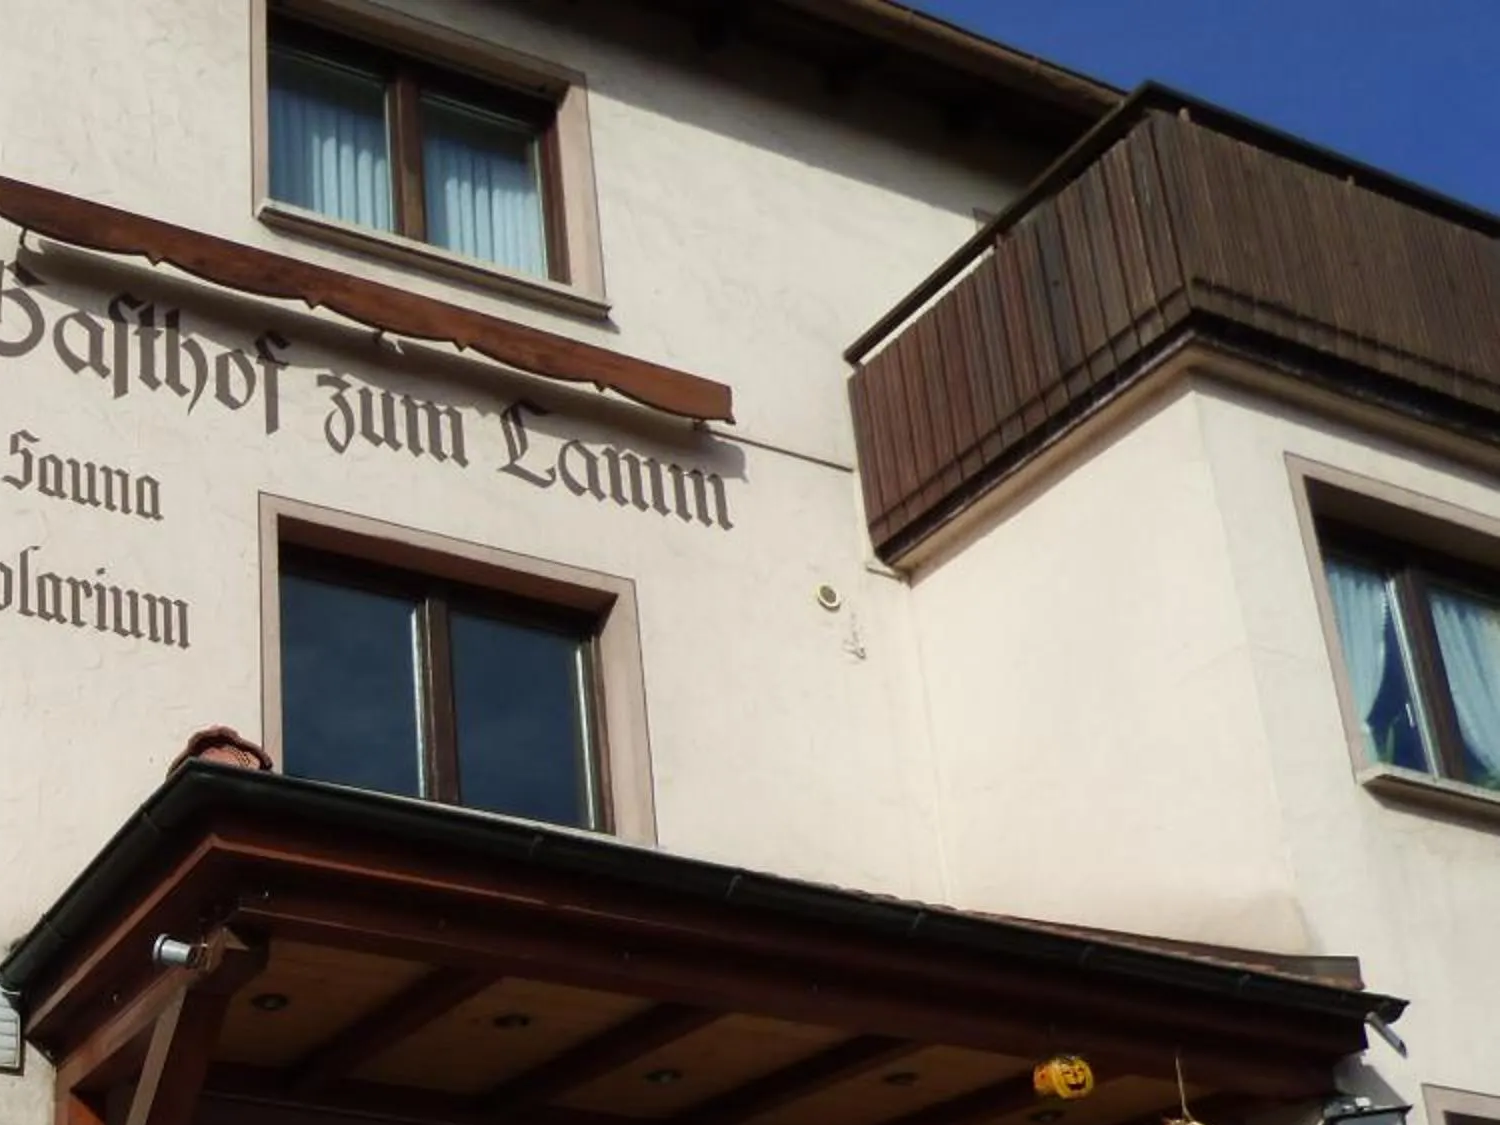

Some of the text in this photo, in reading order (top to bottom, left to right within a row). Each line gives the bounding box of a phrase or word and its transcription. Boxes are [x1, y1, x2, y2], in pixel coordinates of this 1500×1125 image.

[2, 428, 164, 521] Sauna
[316, 372, 468, 468] zum
[498, 401, 735, 530] Lamm
